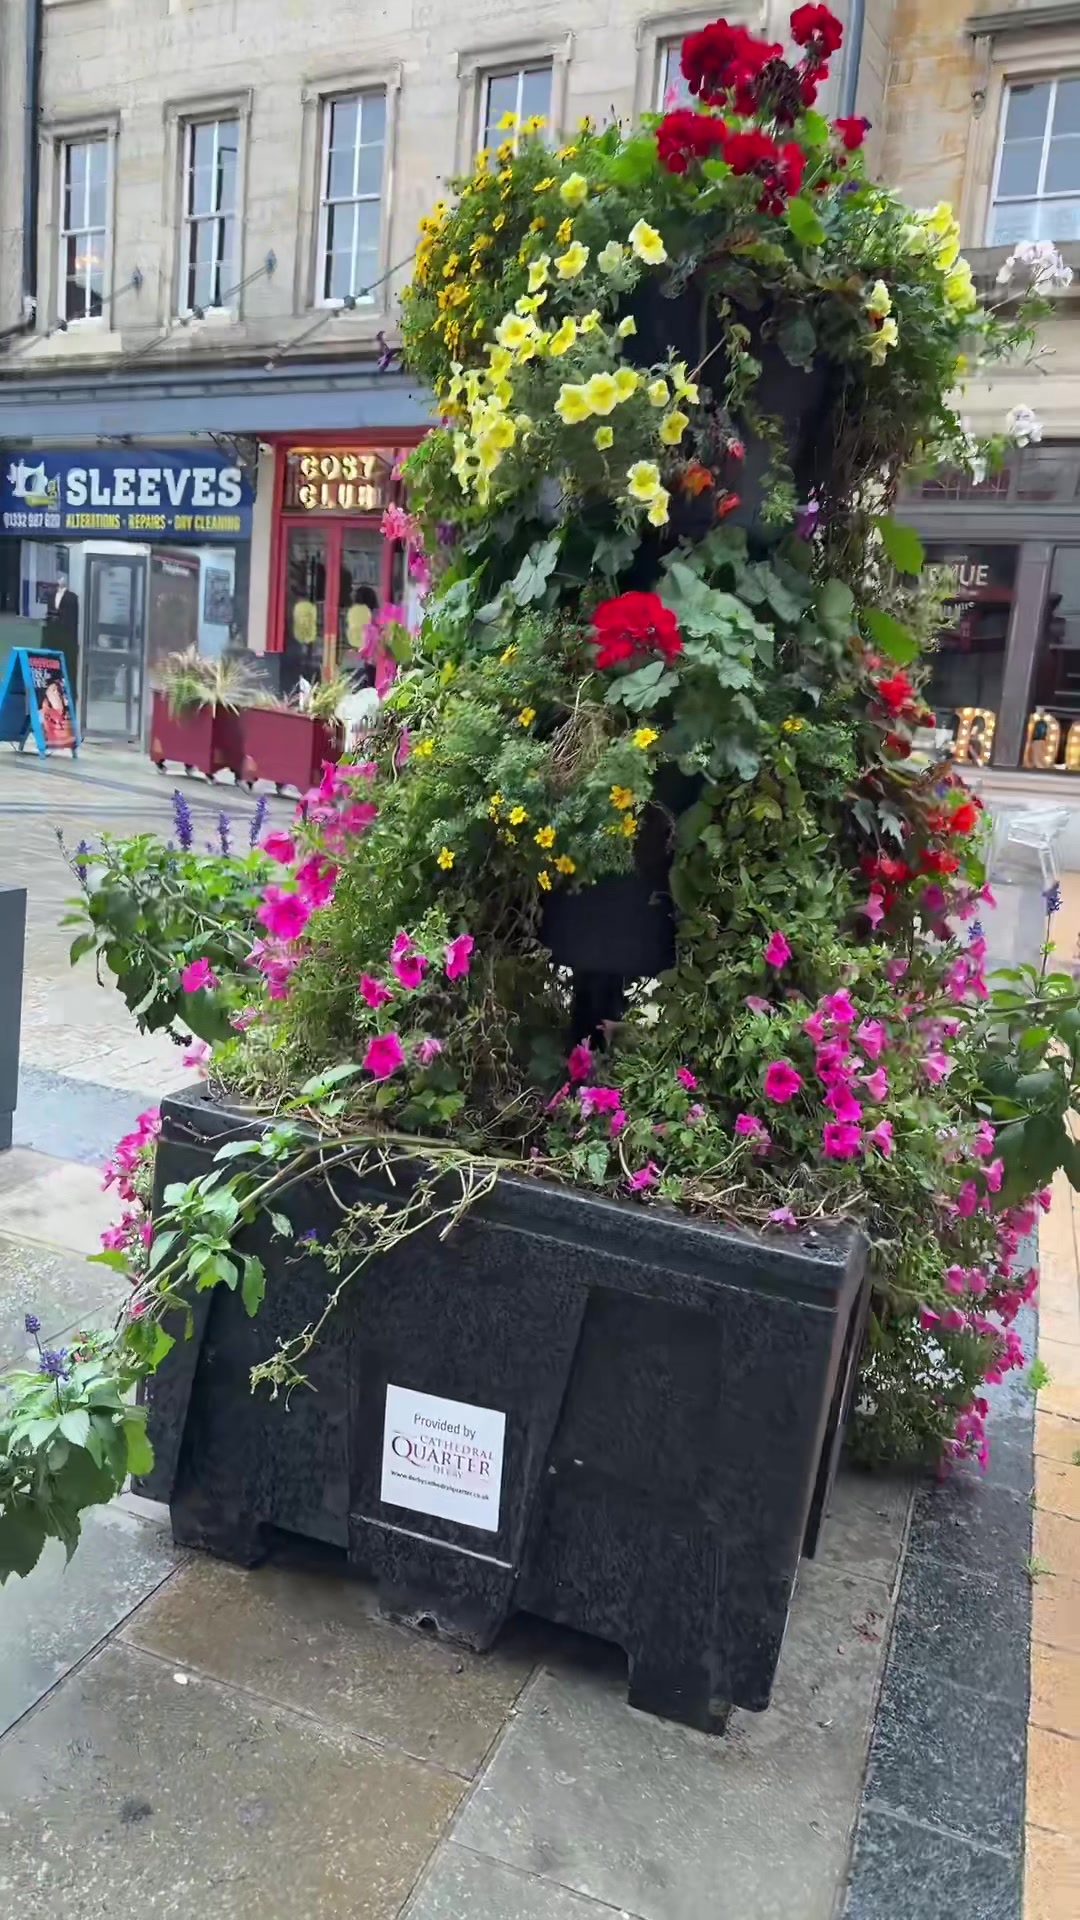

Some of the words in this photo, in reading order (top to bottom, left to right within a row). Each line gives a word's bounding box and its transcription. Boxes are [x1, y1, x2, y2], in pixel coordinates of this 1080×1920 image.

[301, 455, 376, 480] COSY
[66, 468, 242, 507] SLEEVES
[66, 513, 120, 529] ALTERATIONS
[128, 514, 166, 530] REPAIRS
[174, 514, 193, 531] DRY
[194, 515, 240, 532] CLEANING
[413, 1413, 461, 1434] Provided
[463, 1425, 476, 1440] by
[391, 1435, 490, 1476] QUARTER
[420, 1435, 494, 1460] CATHEDRAL
[390, 1470, 489, 1500] www.derbycathedralquarter.co.uk
